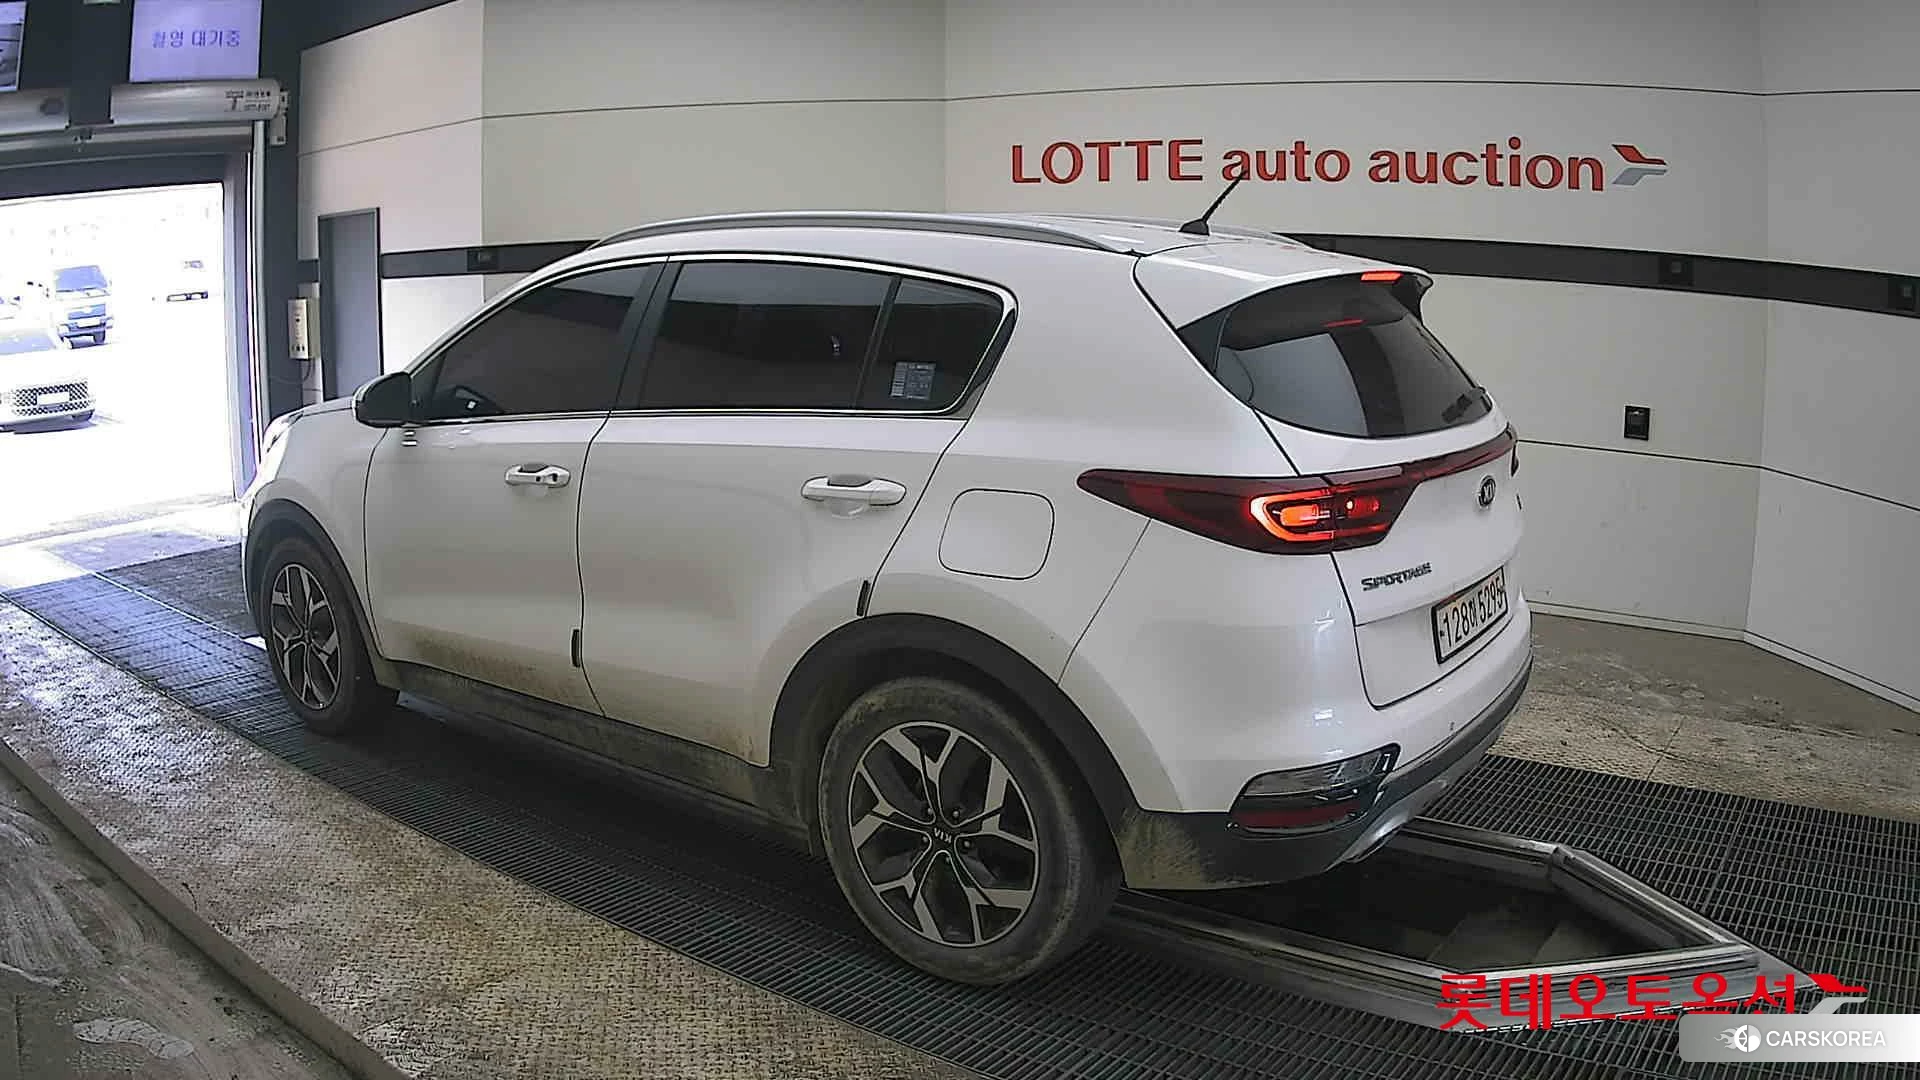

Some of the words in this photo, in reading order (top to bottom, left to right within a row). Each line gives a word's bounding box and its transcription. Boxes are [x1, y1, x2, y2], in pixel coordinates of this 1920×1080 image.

[1011, 139, 1203, 184] LOTTE
[1221, 140, 1350, 183] auto
[1368, 136, 1604, 192] auction
